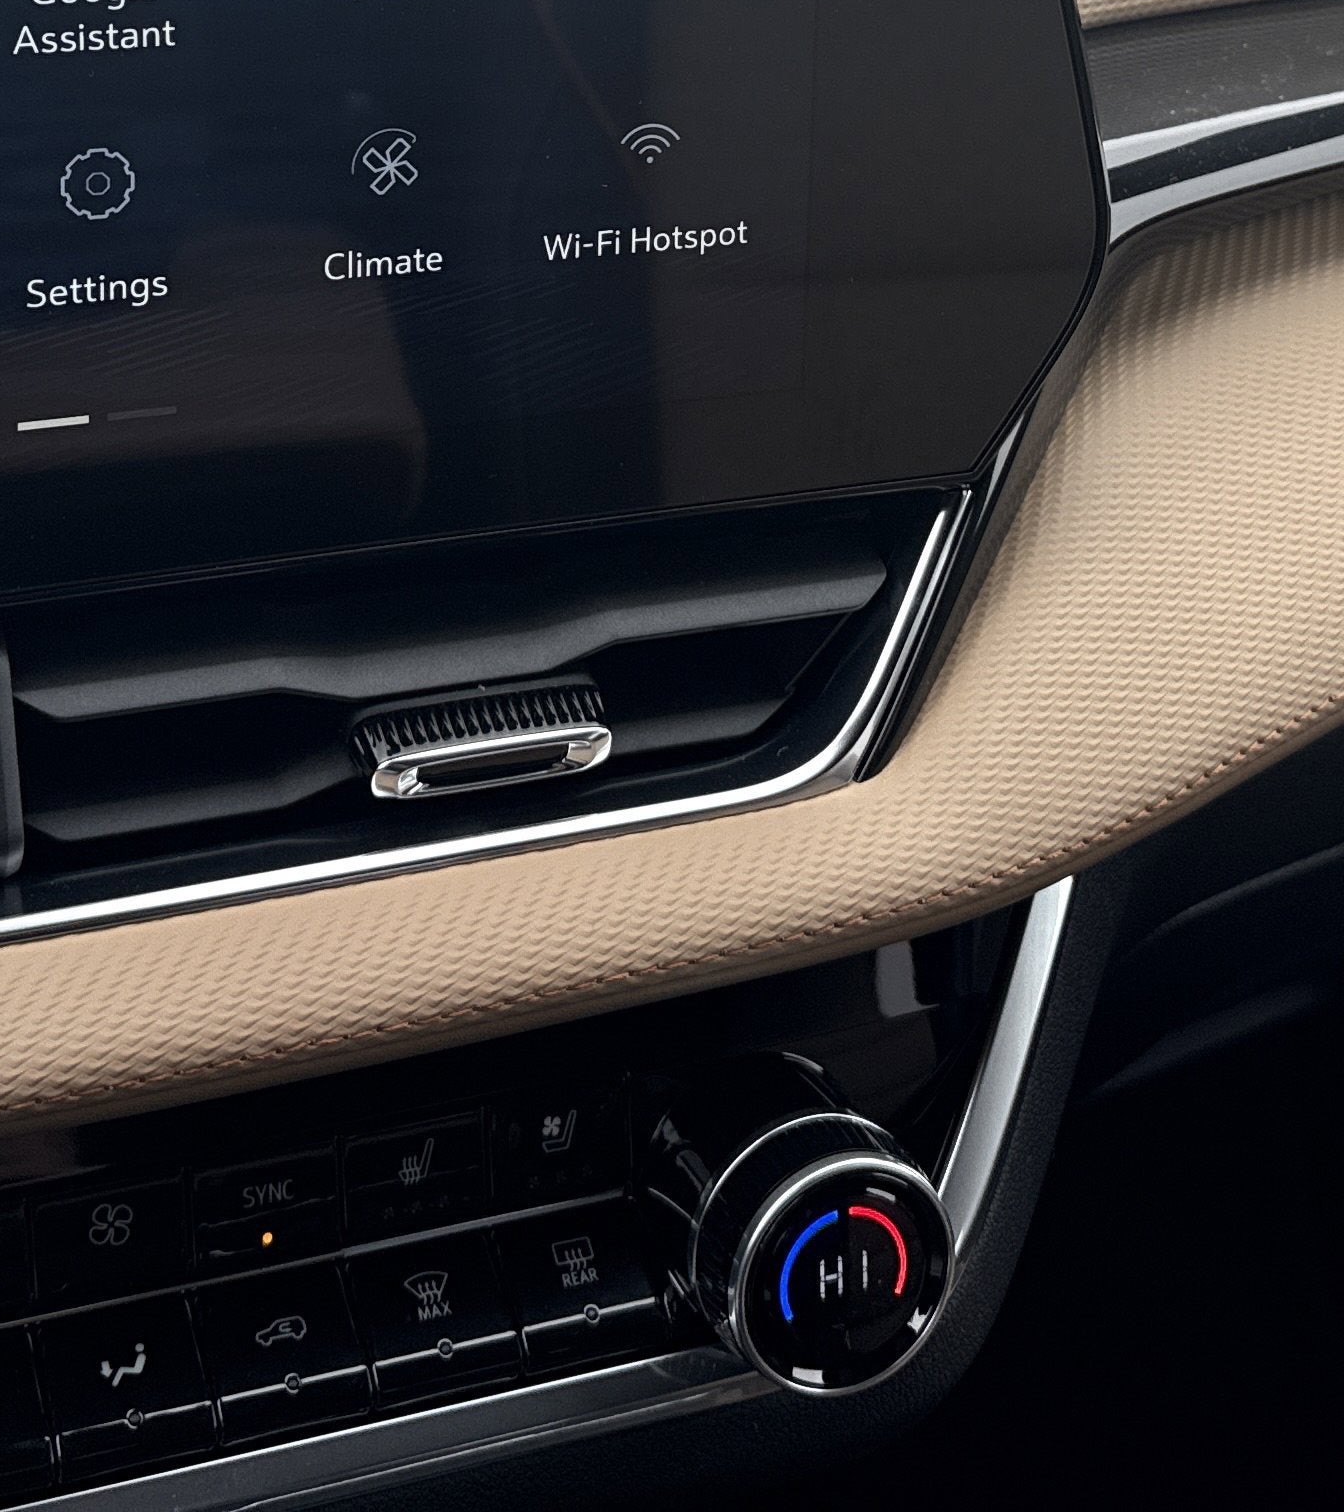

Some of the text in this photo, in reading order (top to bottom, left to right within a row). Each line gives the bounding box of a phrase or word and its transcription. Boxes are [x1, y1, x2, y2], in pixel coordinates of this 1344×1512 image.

[12, 20, 176, 55] Assistant
[543, 220, 749, 262] Wi-Fi Hotspot
[323, 247, 444, 281] Climate
[26, 273, 169, 311] Settings
[242, 1178, 295, 1209] SYNC
[561, 1268, 599, 1288] REAR
[819, 1249, 869, 1302] HI
[417, 1300, 452, 1321] MAX
